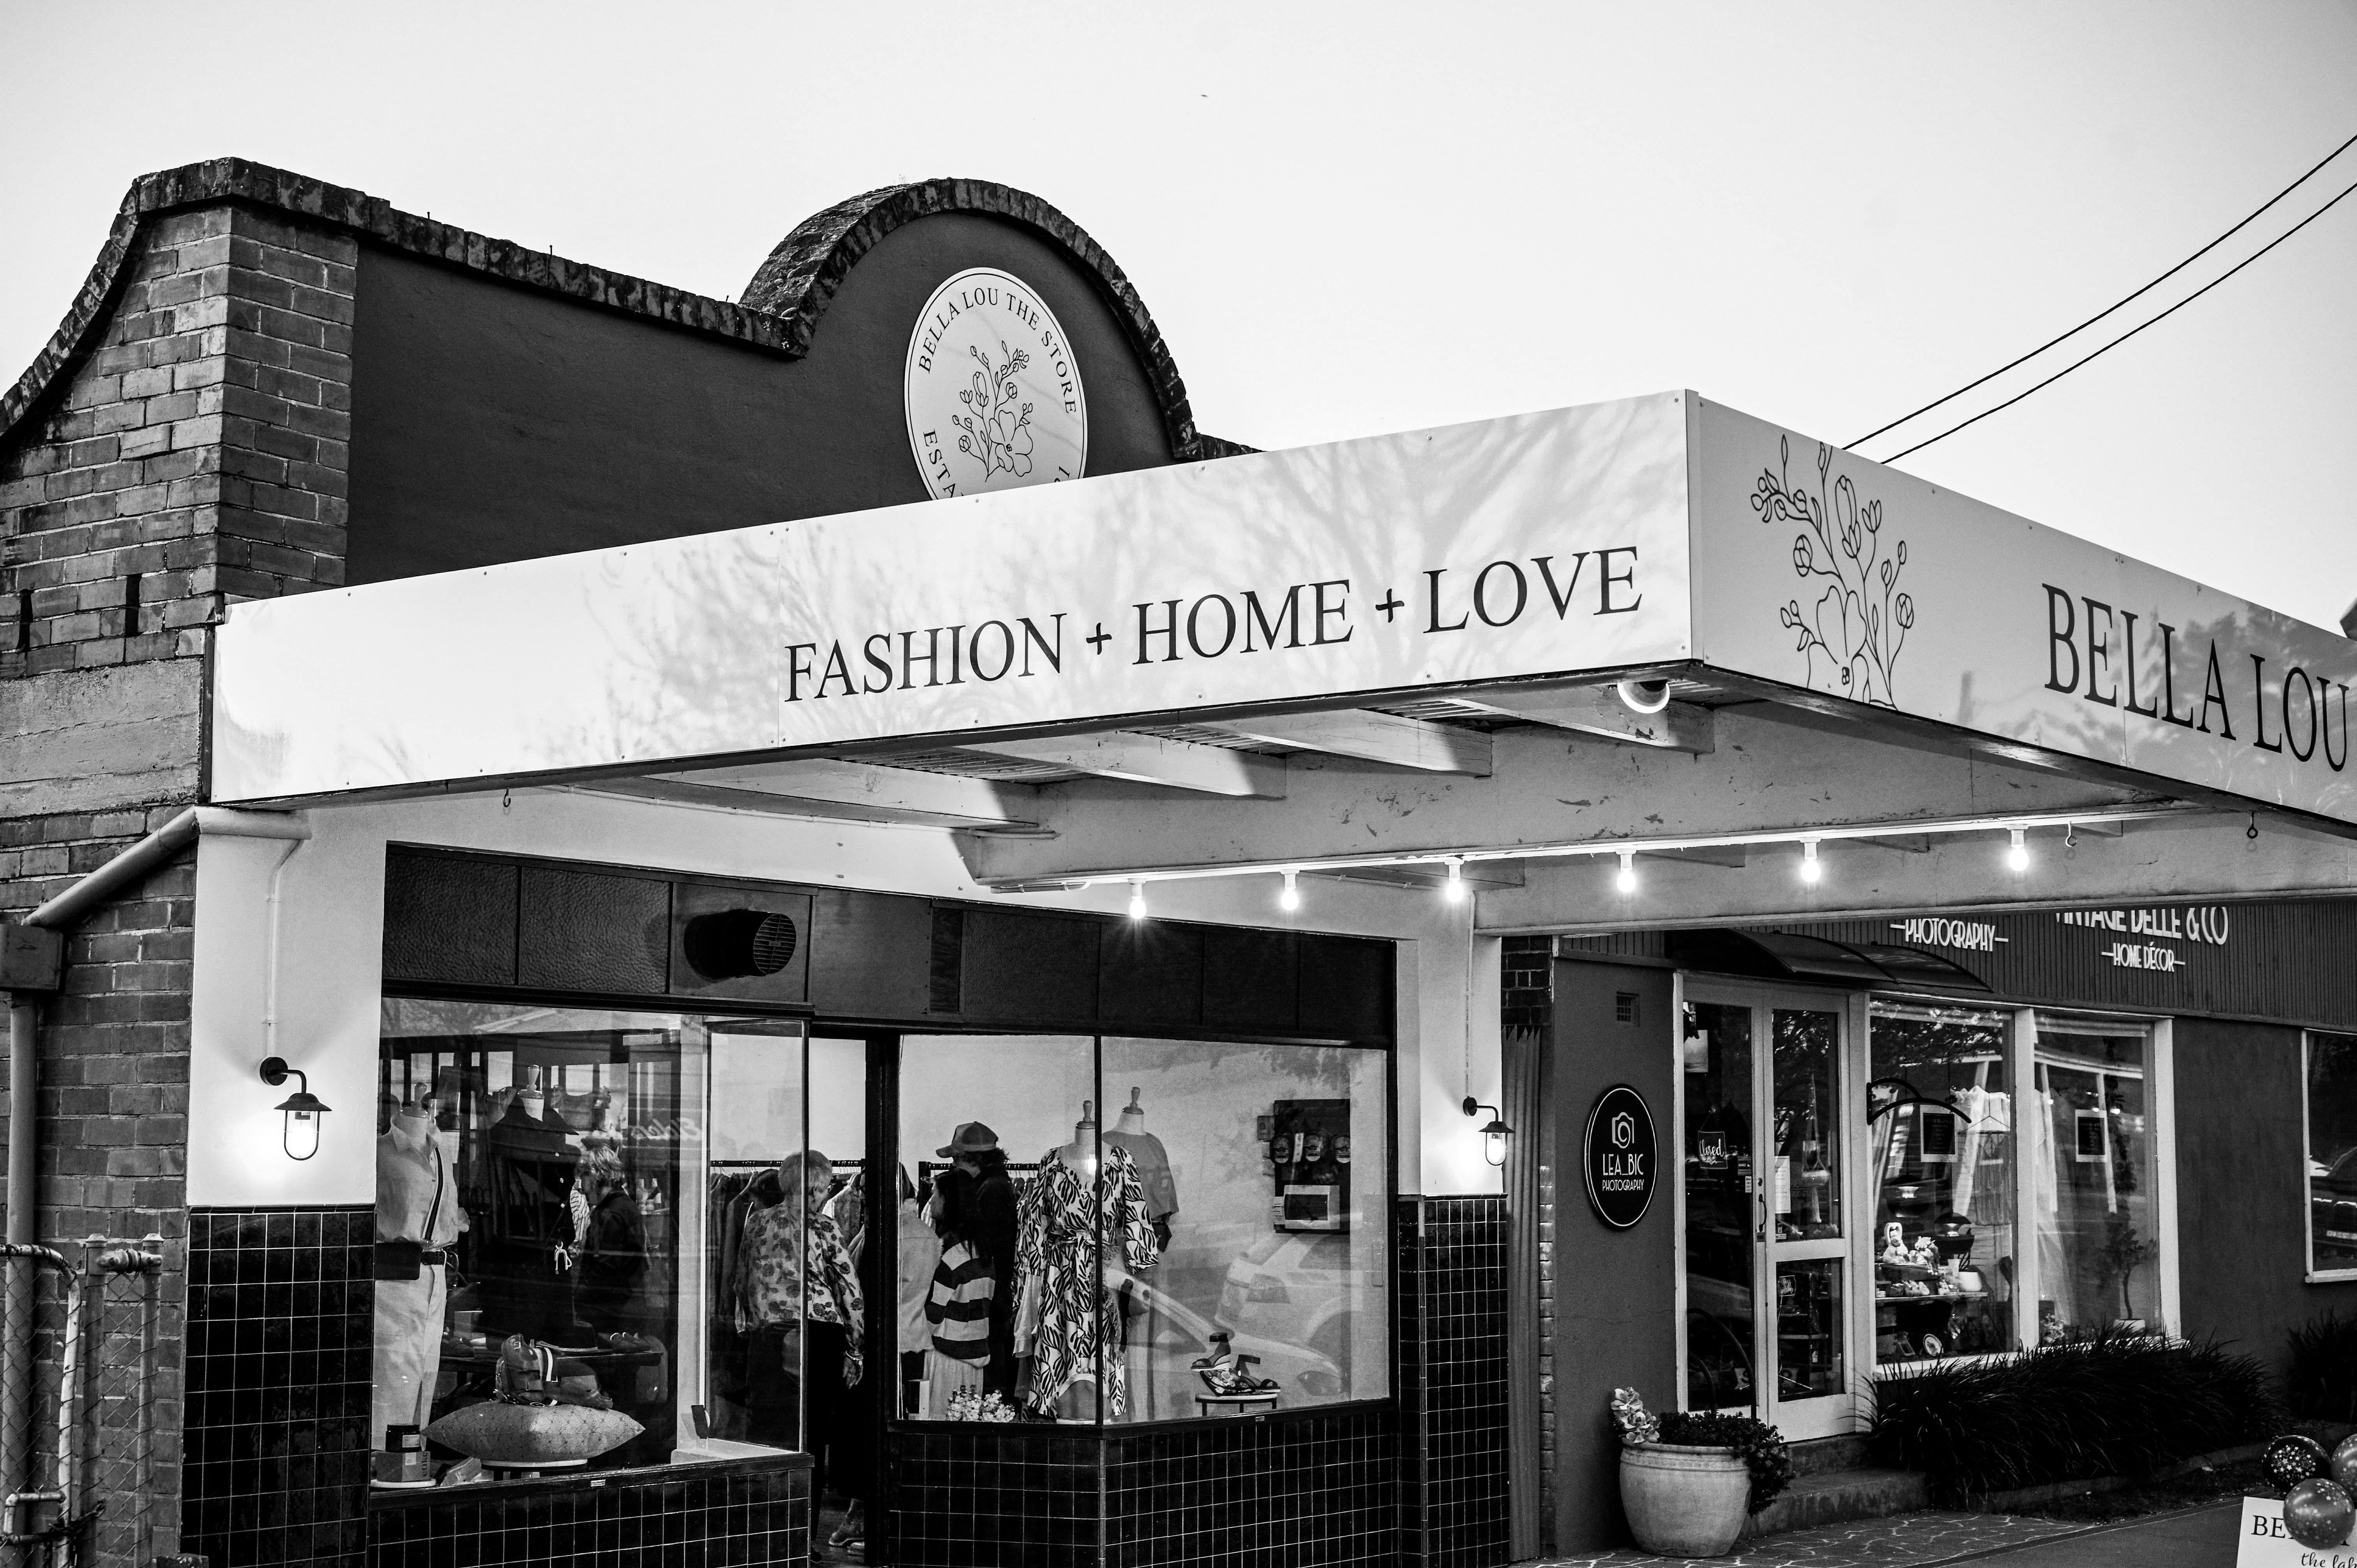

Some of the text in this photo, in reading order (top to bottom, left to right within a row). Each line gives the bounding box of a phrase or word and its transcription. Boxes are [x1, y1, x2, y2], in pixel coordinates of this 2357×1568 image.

[919, 288, 1076, 414] BELLA LOU THE STORE
[923, 429, 964, 498] ESTA
[784, 613, 1067, 703] FASHION
[1132, 579, 1353, 665] HOME
[1422, 546, 1642, 634] LOVE
[2042, 583, 2349, 772] BELLA LOU
[1905, 918, 1996, 952] PHOTOGRAPHY
[2201, 906, 2228, 945] CO
[2113, 941, 2175, 972] HOME DÉCOR
[1602, 1179, 1644, 1191] PHOTOGRAPHY
[2301, 1552, 2325, 1568] the
